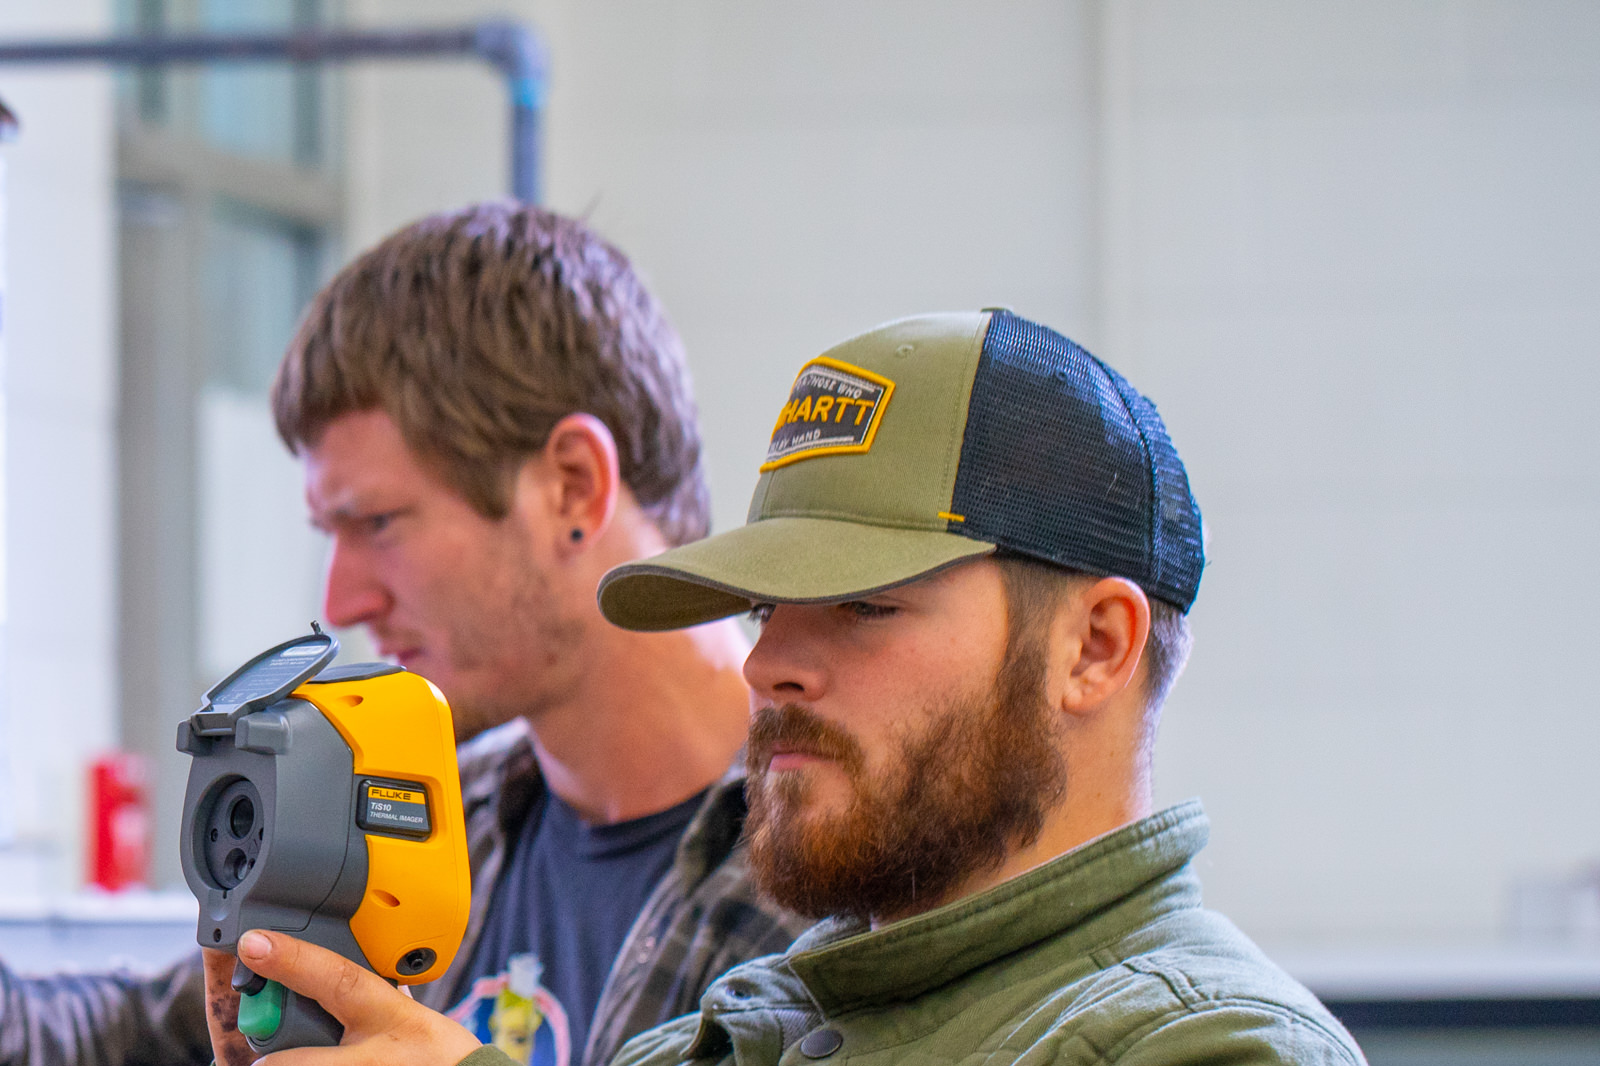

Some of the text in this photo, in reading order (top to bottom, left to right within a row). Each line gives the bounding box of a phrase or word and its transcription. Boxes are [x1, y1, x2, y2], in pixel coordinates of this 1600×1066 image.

[837, 382, 863, 399] WHO
[780, 395, 875, 426] HARTT
[791, 428, 821, 446] HAND
[371, 789, 412, 801] FLUKE
[370, 802, 392, 812] TiS10
[369, 811, 424, 824] THERMAL IMAGER
